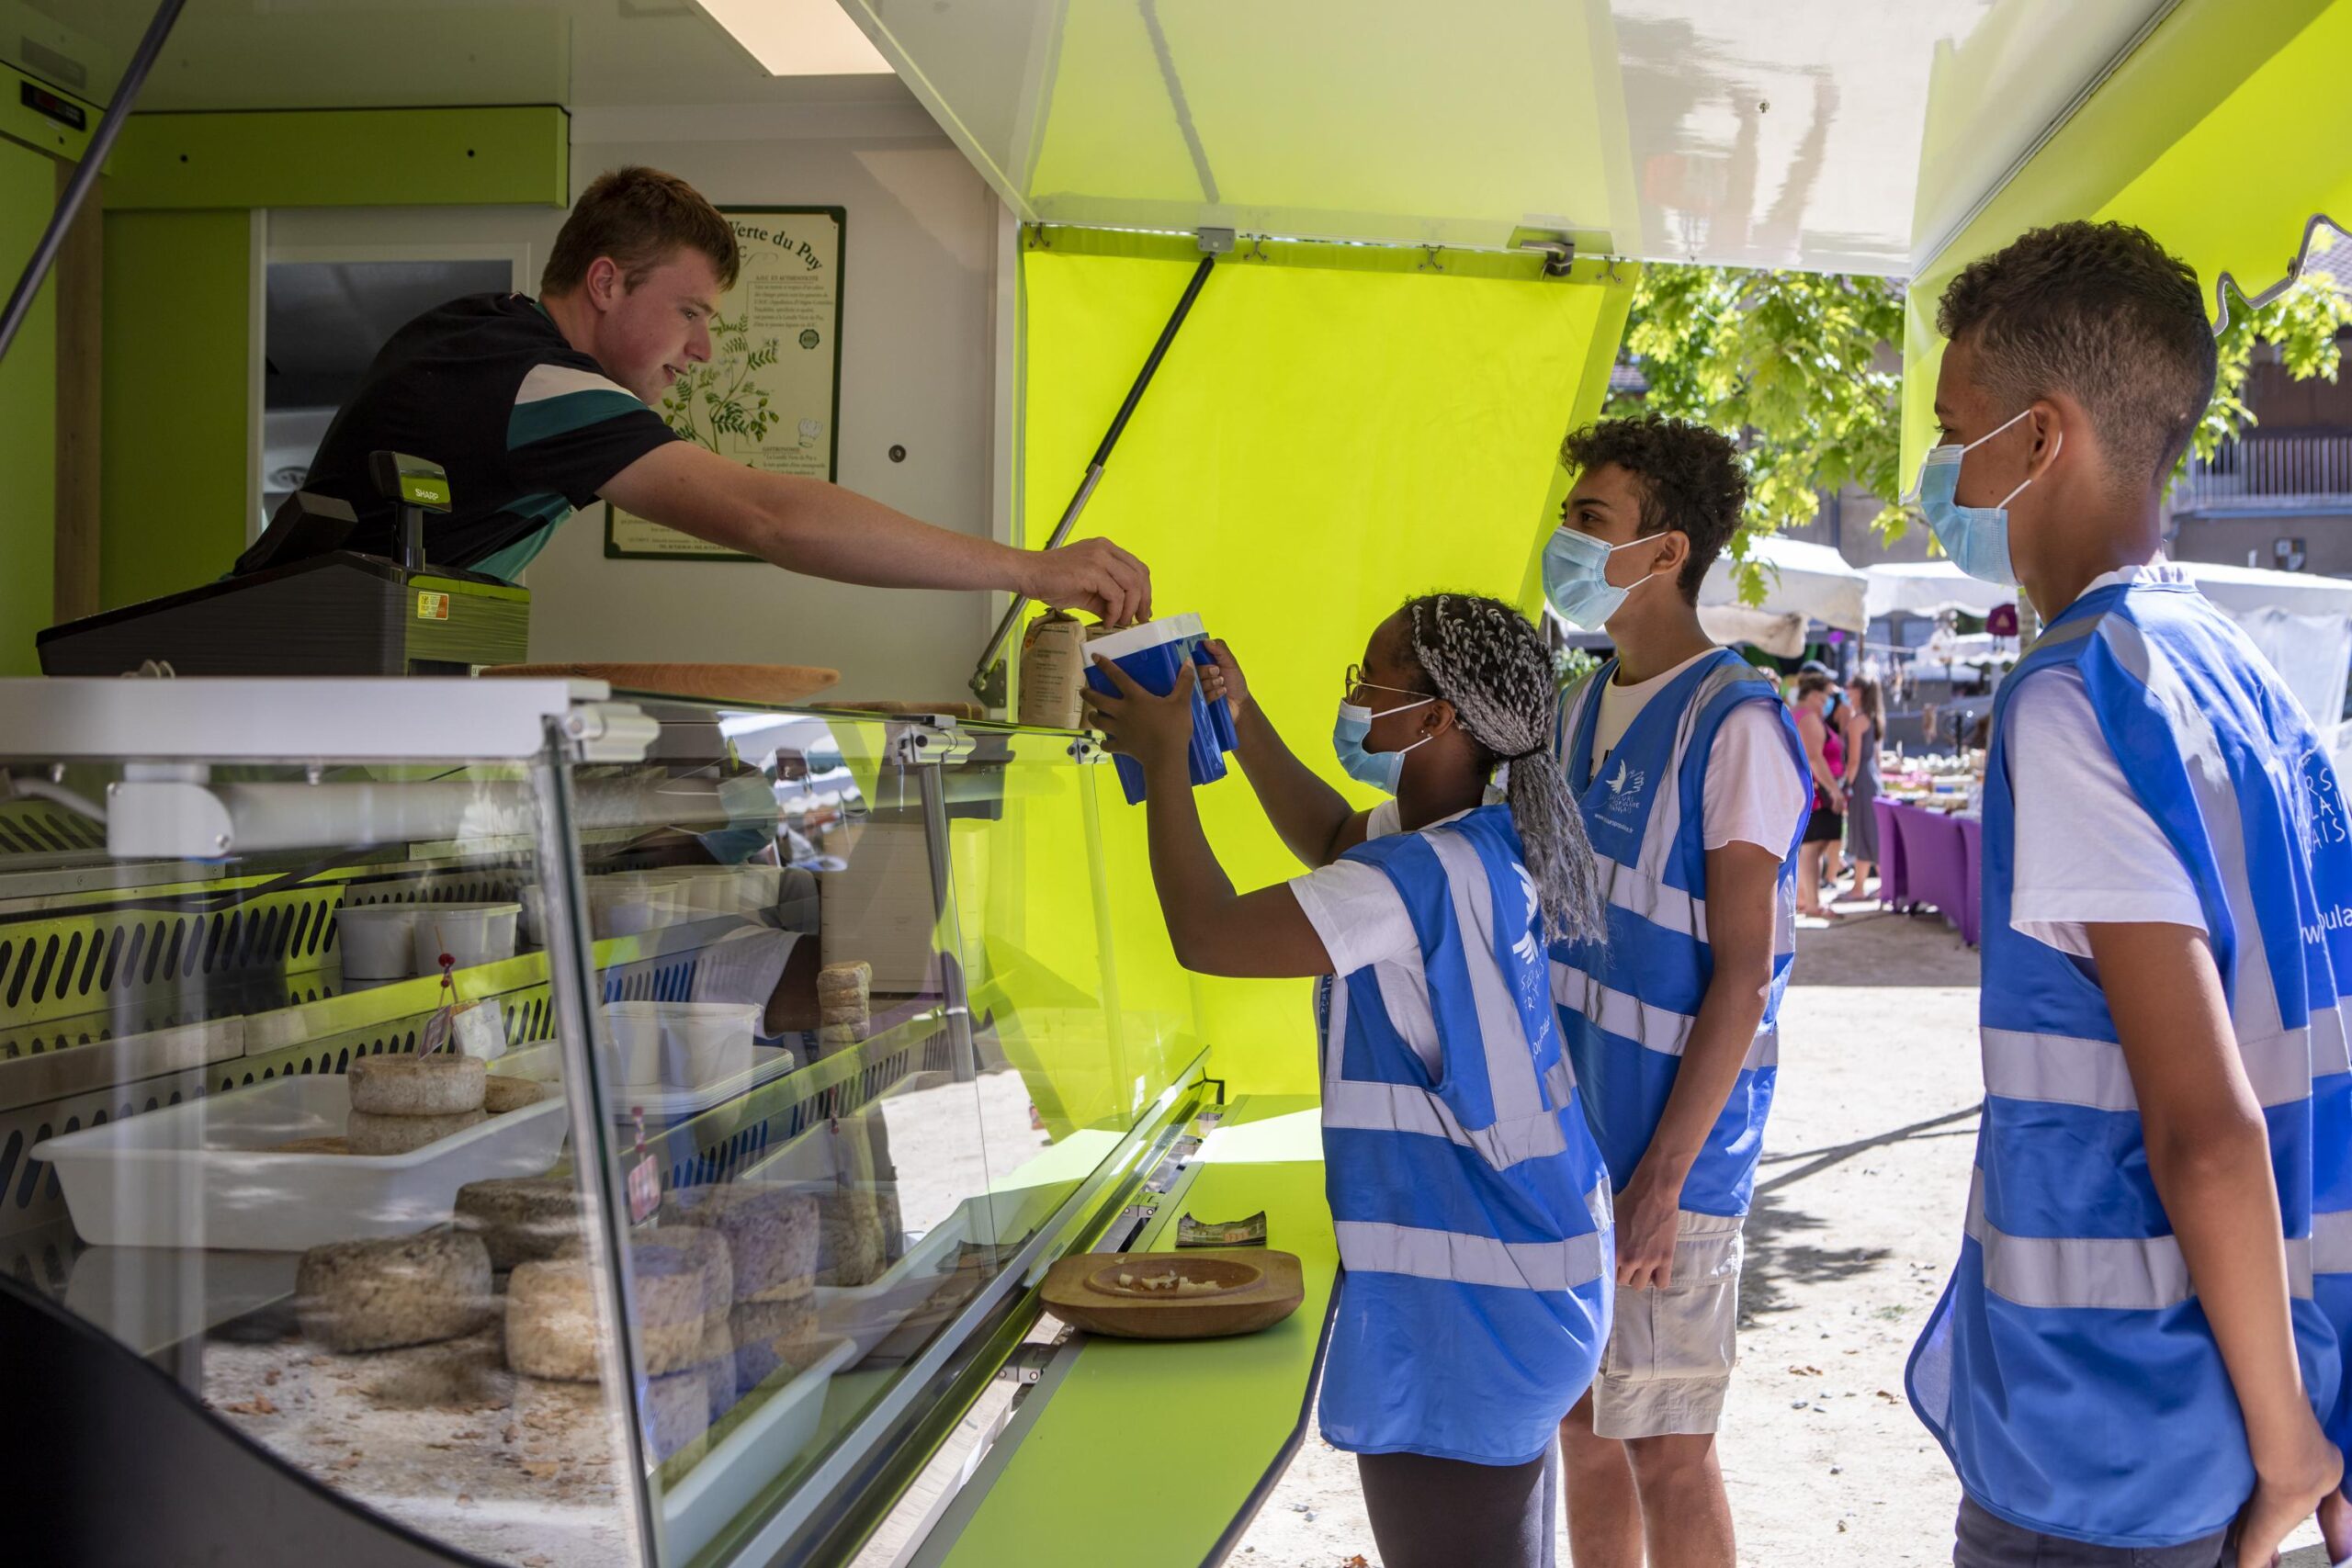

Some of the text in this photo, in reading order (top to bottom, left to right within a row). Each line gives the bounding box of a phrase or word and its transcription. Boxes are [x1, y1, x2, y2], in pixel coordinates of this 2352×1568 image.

[729, 220, 822, 271] Verte du Puy
[415, 488, 438, 501] SHARP
